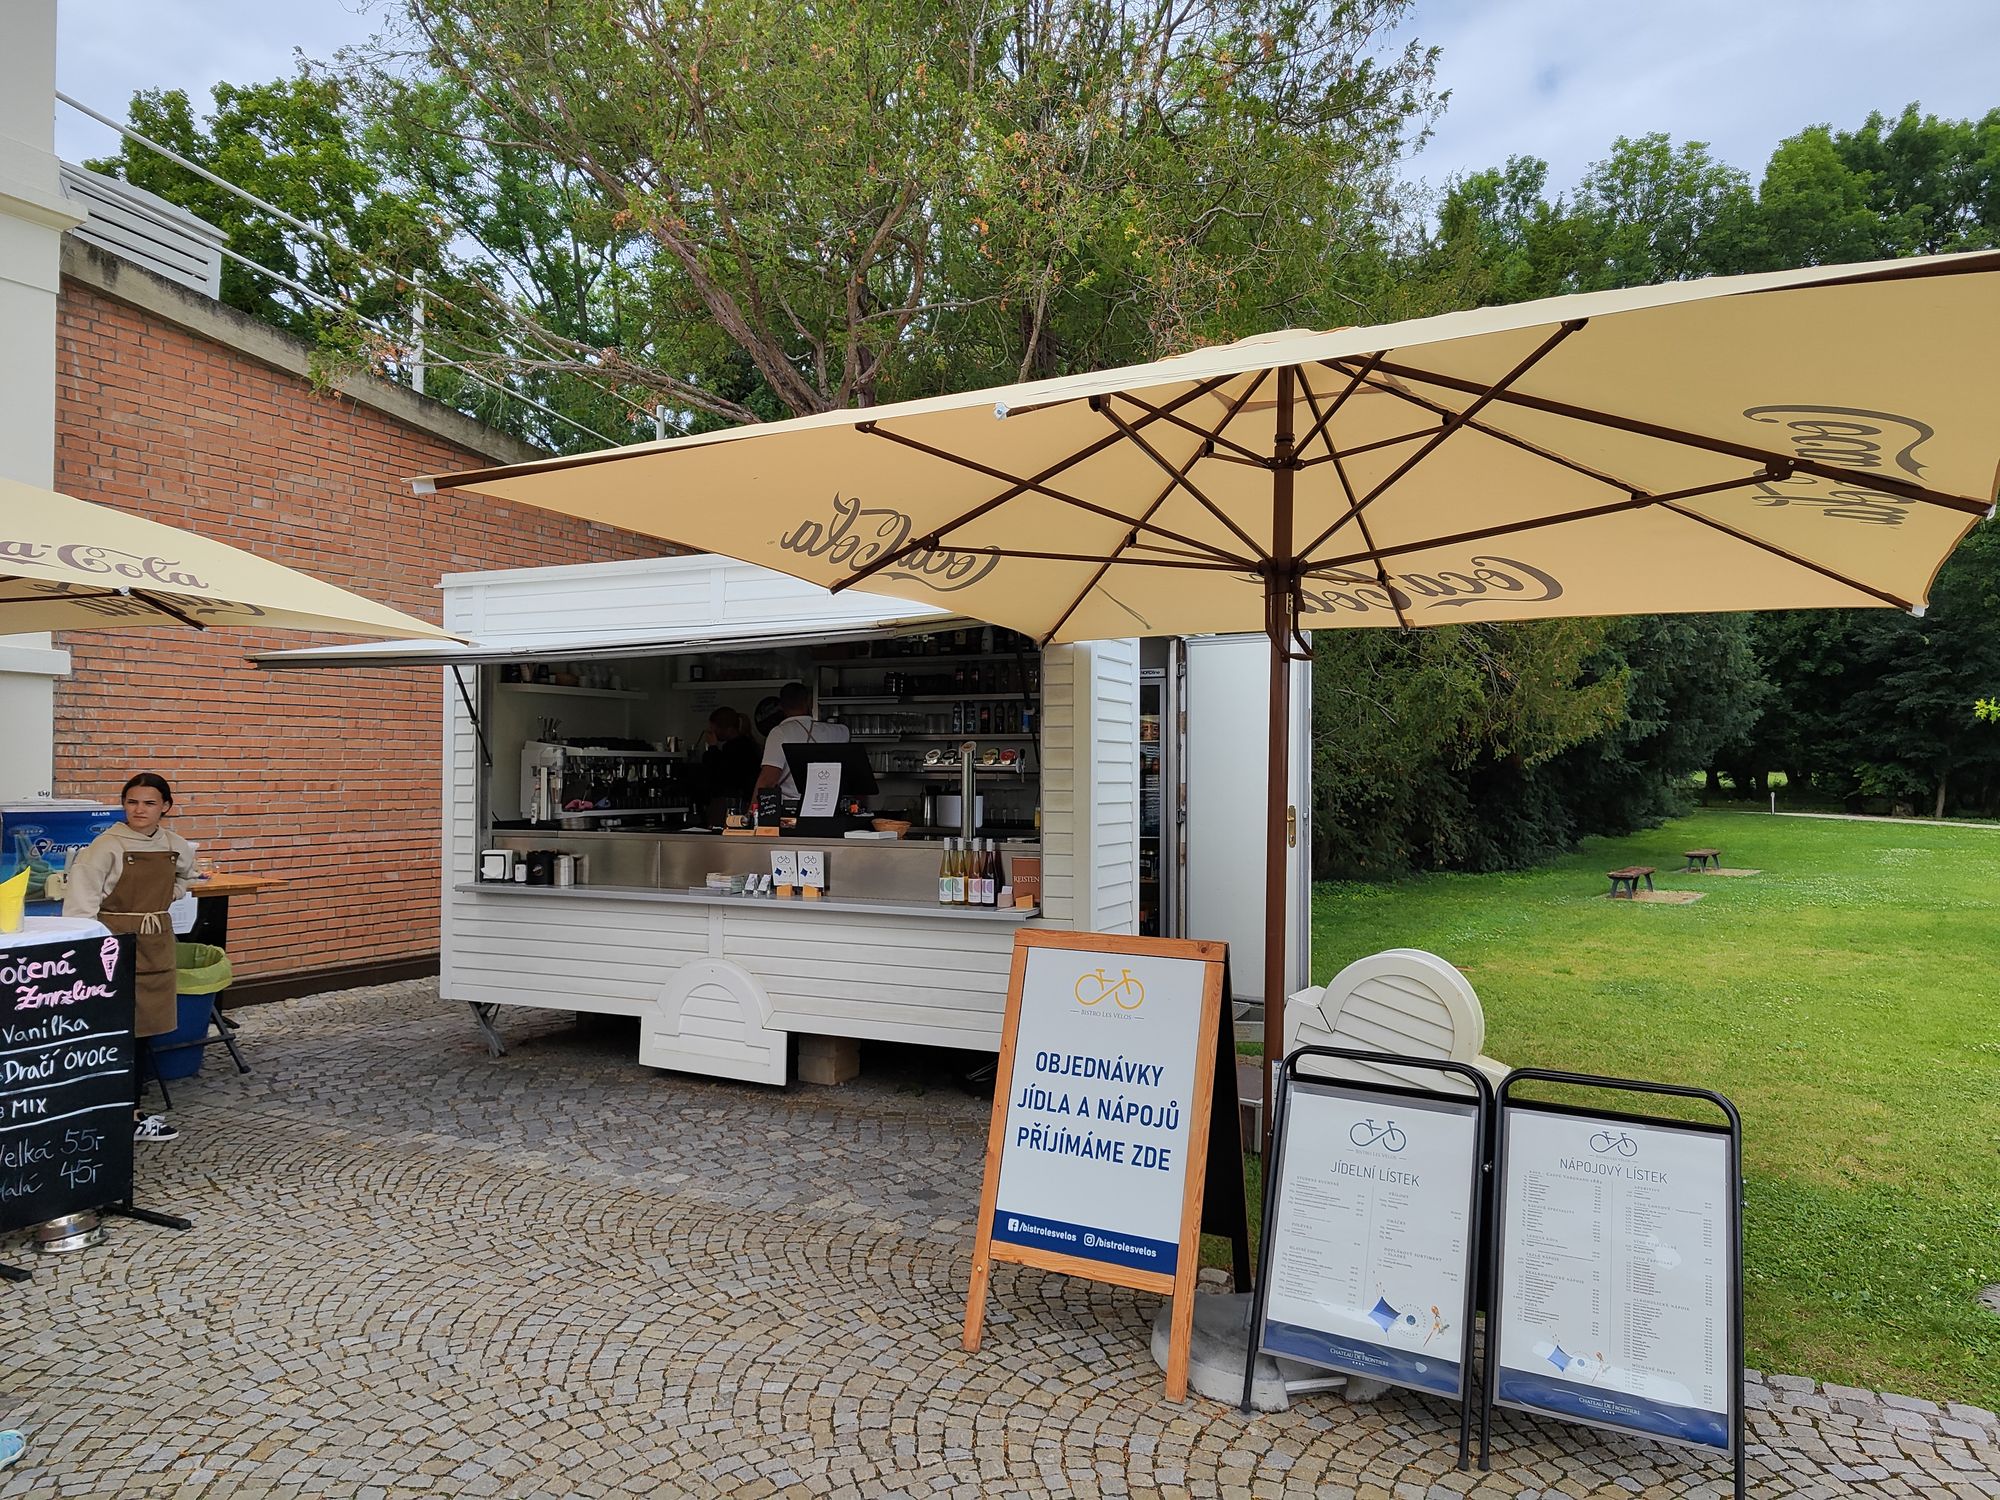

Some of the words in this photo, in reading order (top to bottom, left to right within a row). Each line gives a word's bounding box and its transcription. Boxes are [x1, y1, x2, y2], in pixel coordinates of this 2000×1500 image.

[2, 1014, 90, 1044] Vanilka
[3, 1048, 61, 1085] Dračí
[1035, 1051, 1164, 1087] OBJEDNÁVKY
[11, 1097, 48, 1119] MIX
[1017, 1082, 1070, 1115] JÍDLA
[1076, 1096, 1090, 1118] A
[1097, 1094, 1180, 1131] NÁPOJŮ
[1016, 1121, 1125, 1164] PŘÍJÍMÁME
[1131, 1143, 1172, 1172] ZDE
[1330, 1159, 1377, 1179] JÍDELNÍ
[1379, 1167, 1420, 1187] LÍSTEK
[1559, 1156, 1622, 1177] NÁPOJOVÝ
[1626, 1166, 1668, 1184] LÍSTEK
[1019, 1222, 1077, 1242] /bistrolesvelos
[1095, 1236, 1157, 1258] /bistrolesvelos
